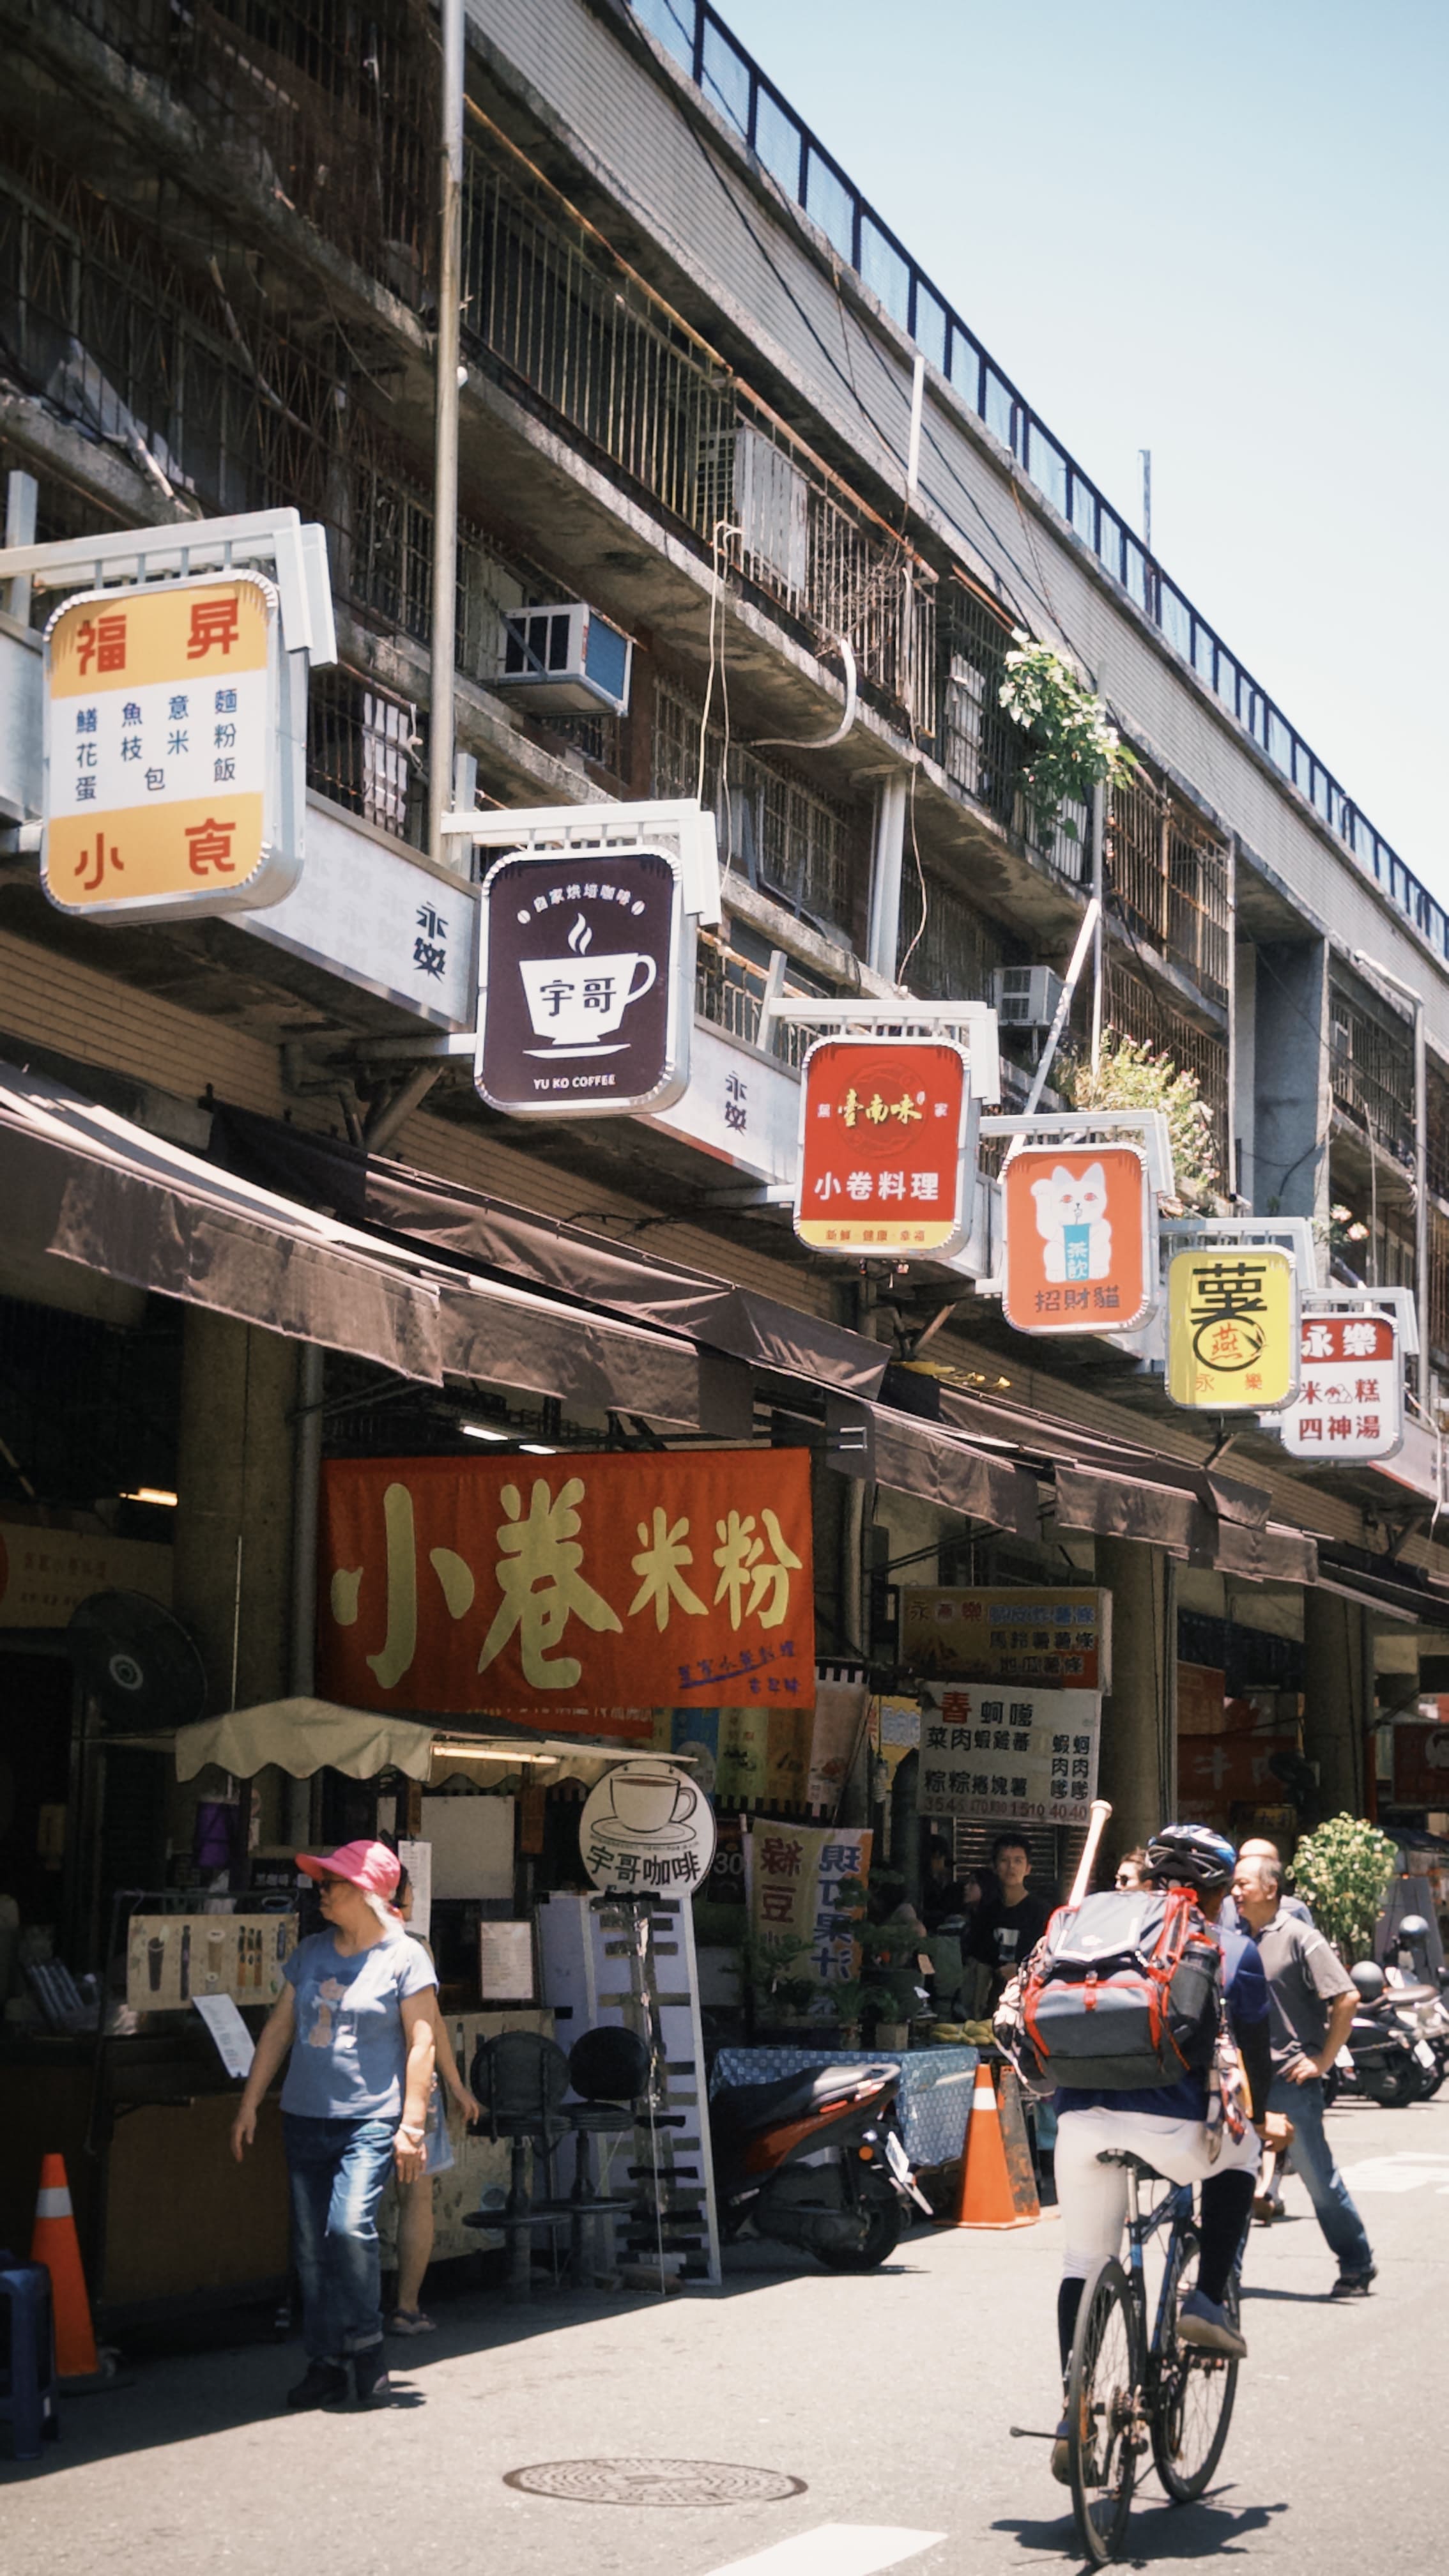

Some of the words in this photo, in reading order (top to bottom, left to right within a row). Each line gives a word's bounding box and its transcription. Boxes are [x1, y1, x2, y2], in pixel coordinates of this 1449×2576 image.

[77, 599, 239, 675] 福昇
[76, 689, 237, 733] 鱔魚意麵
[76, 723, 236, 767] 花枝米粉
[75, 758, 236, 801] 蛋包飯
[75, 818, 236, 889] 小食
[533, 883, 631, 912] 自家烘焙咖啡
[540, 977, 617, 1017] 宇哥
[533, 1078, 549, 1090] YU
[553, 1077, 569, 1089] KO
[572, 1074, 615, 1087] COFFEE
[815, 1171, 939, 1200] 小卷料理
[1066, 1241, 1089, 1278] 茶飲
[1035, 1285, 1120, 1312] 招財貓
[1301, 1323, 1377, 1358] 永樂
[1196, 1374, 1262, 1391] 永樂
[1299, 1379, 1380, 1404] 米糕
[1300, 1416, 1380, 1441] 四神湯
[331, 1477, 802, 1689] 小卷米粉
[938, 1691, 972, 1724] 春
[586, 1844, 701, 1885] 宇哥咖啡
